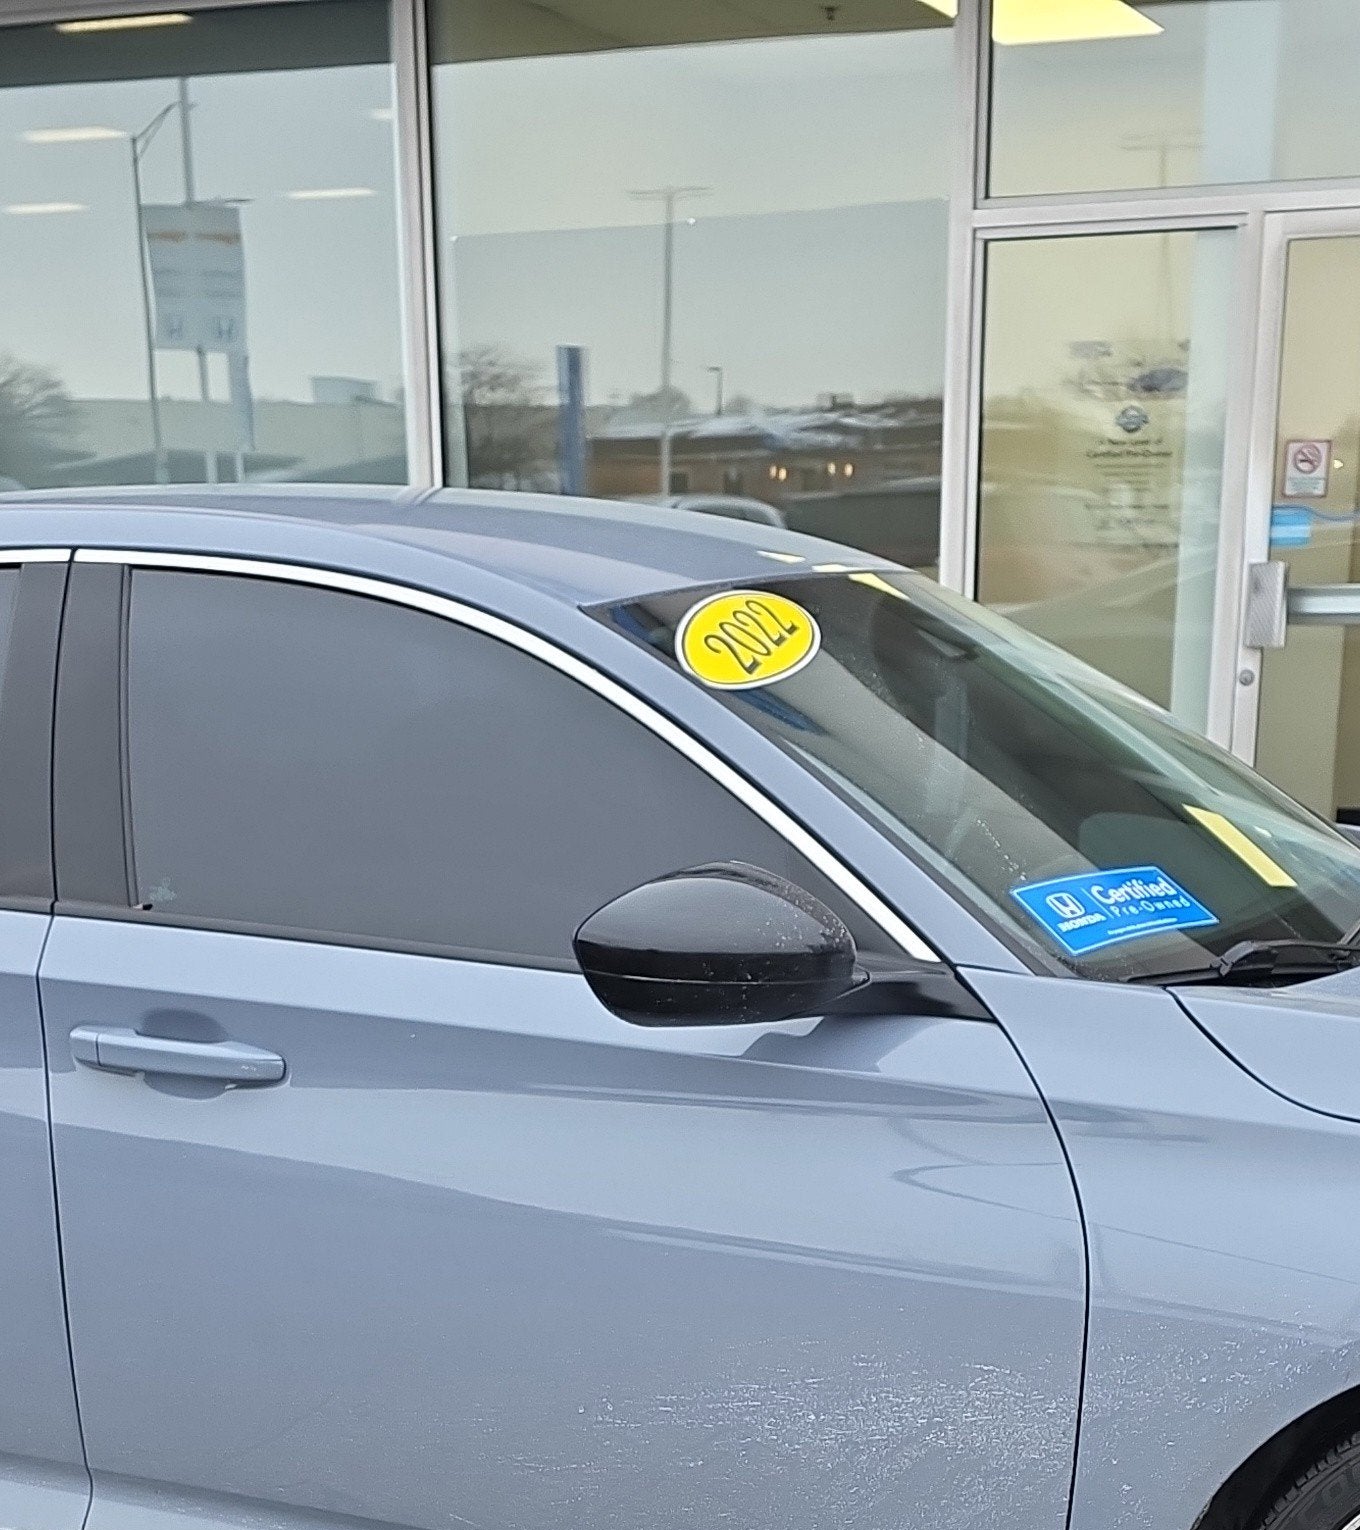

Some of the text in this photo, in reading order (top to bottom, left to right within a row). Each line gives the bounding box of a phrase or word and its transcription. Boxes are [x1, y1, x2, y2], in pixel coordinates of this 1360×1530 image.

[703, 599, 800, 675] 2022
[1090, 876, 1177, 905] Certified
[1110, 894, 1191, 917] Pre-Owned
[1056, 912, 1108, 933] HONDA
